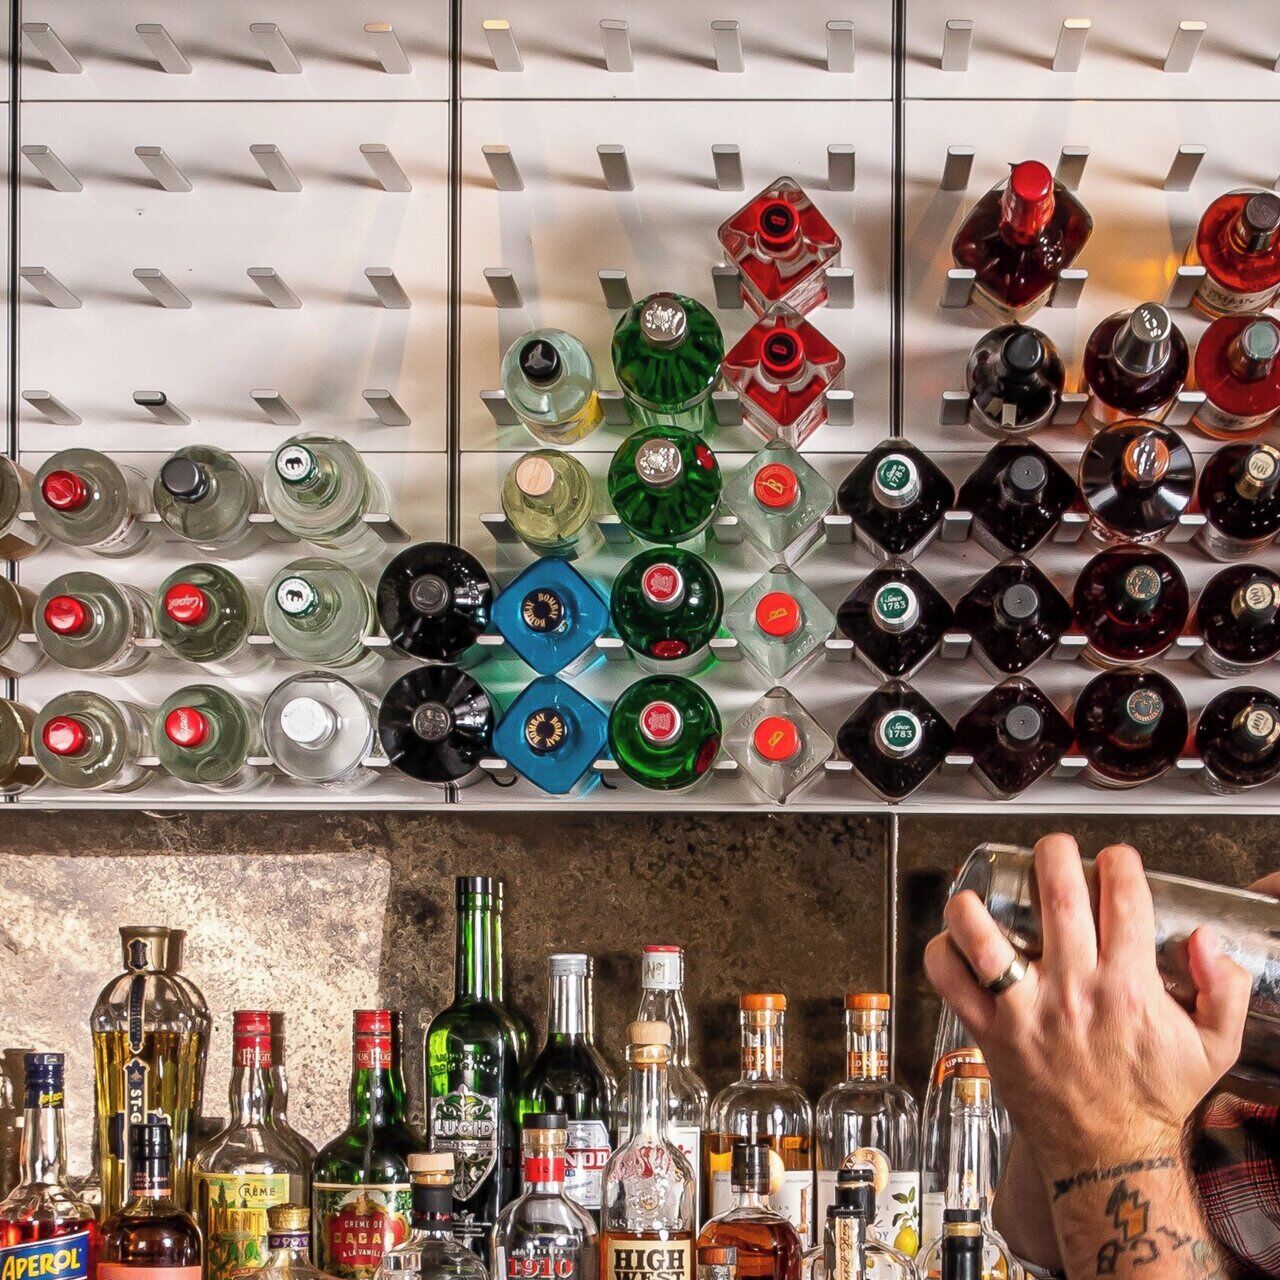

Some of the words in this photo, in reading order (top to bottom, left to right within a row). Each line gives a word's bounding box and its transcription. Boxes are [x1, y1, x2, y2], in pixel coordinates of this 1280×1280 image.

[889, 464, 907, 488] 1783
[167, 595, 200, 611] Capel
[882, 602, 907, 612] 1783
[888, 730, 913, 739] 1783
[433, 1118, 496, 1137] LUCID
[507, 1257, 575, 1279] 1910
[613, 1248, 685, 1271] HIGH
